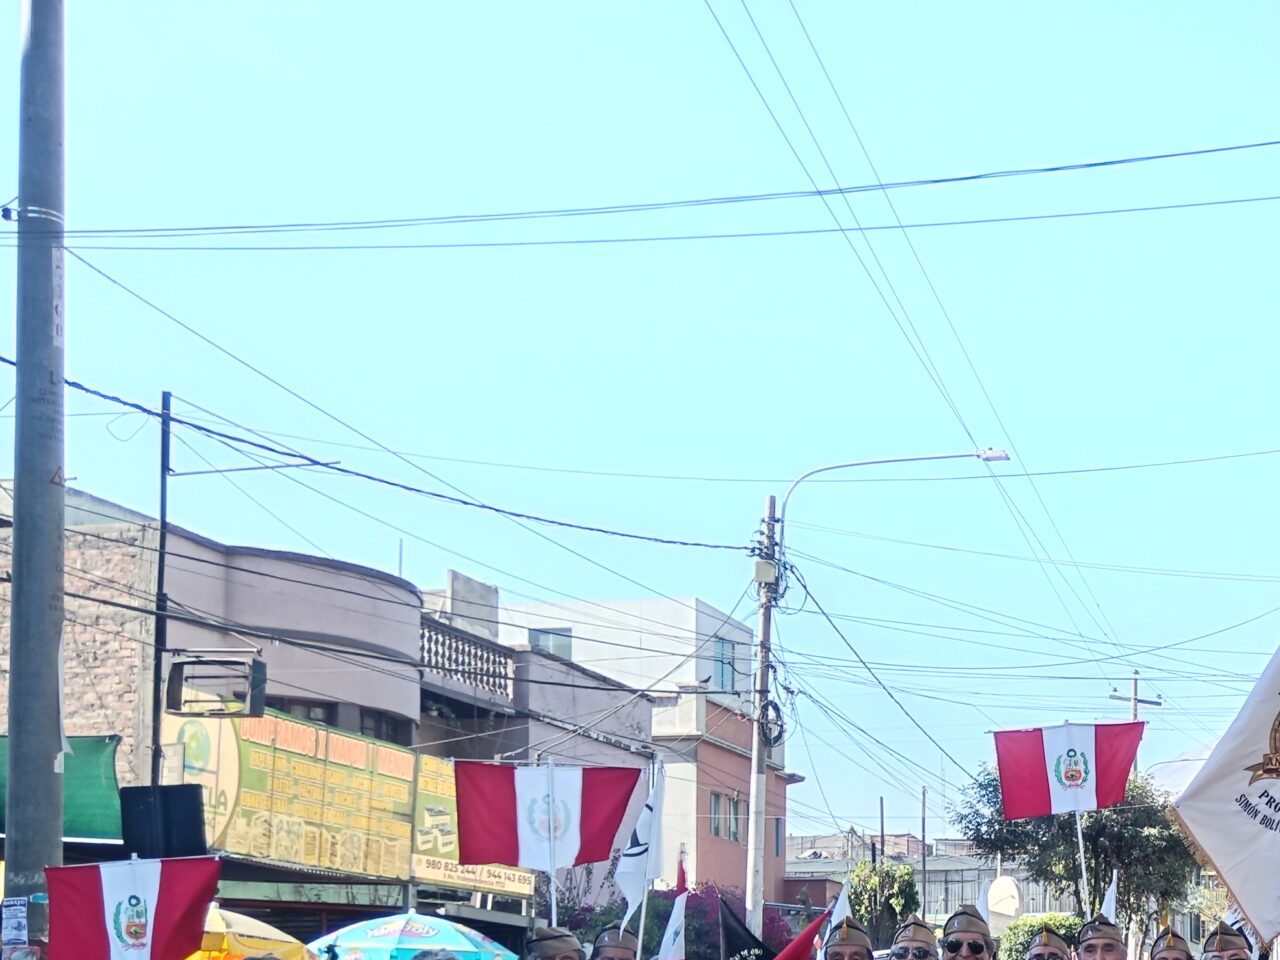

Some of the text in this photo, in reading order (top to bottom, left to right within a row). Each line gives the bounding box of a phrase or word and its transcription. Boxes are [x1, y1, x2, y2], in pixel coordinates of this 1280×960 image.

[1235, 793, 1261, 821] SIMÓN
[425, 858, 442, 871] 980
[443, 860, 459, 874] 825
[486, 868, 502, 880] 944
[517, 874, 532, 886] 695
